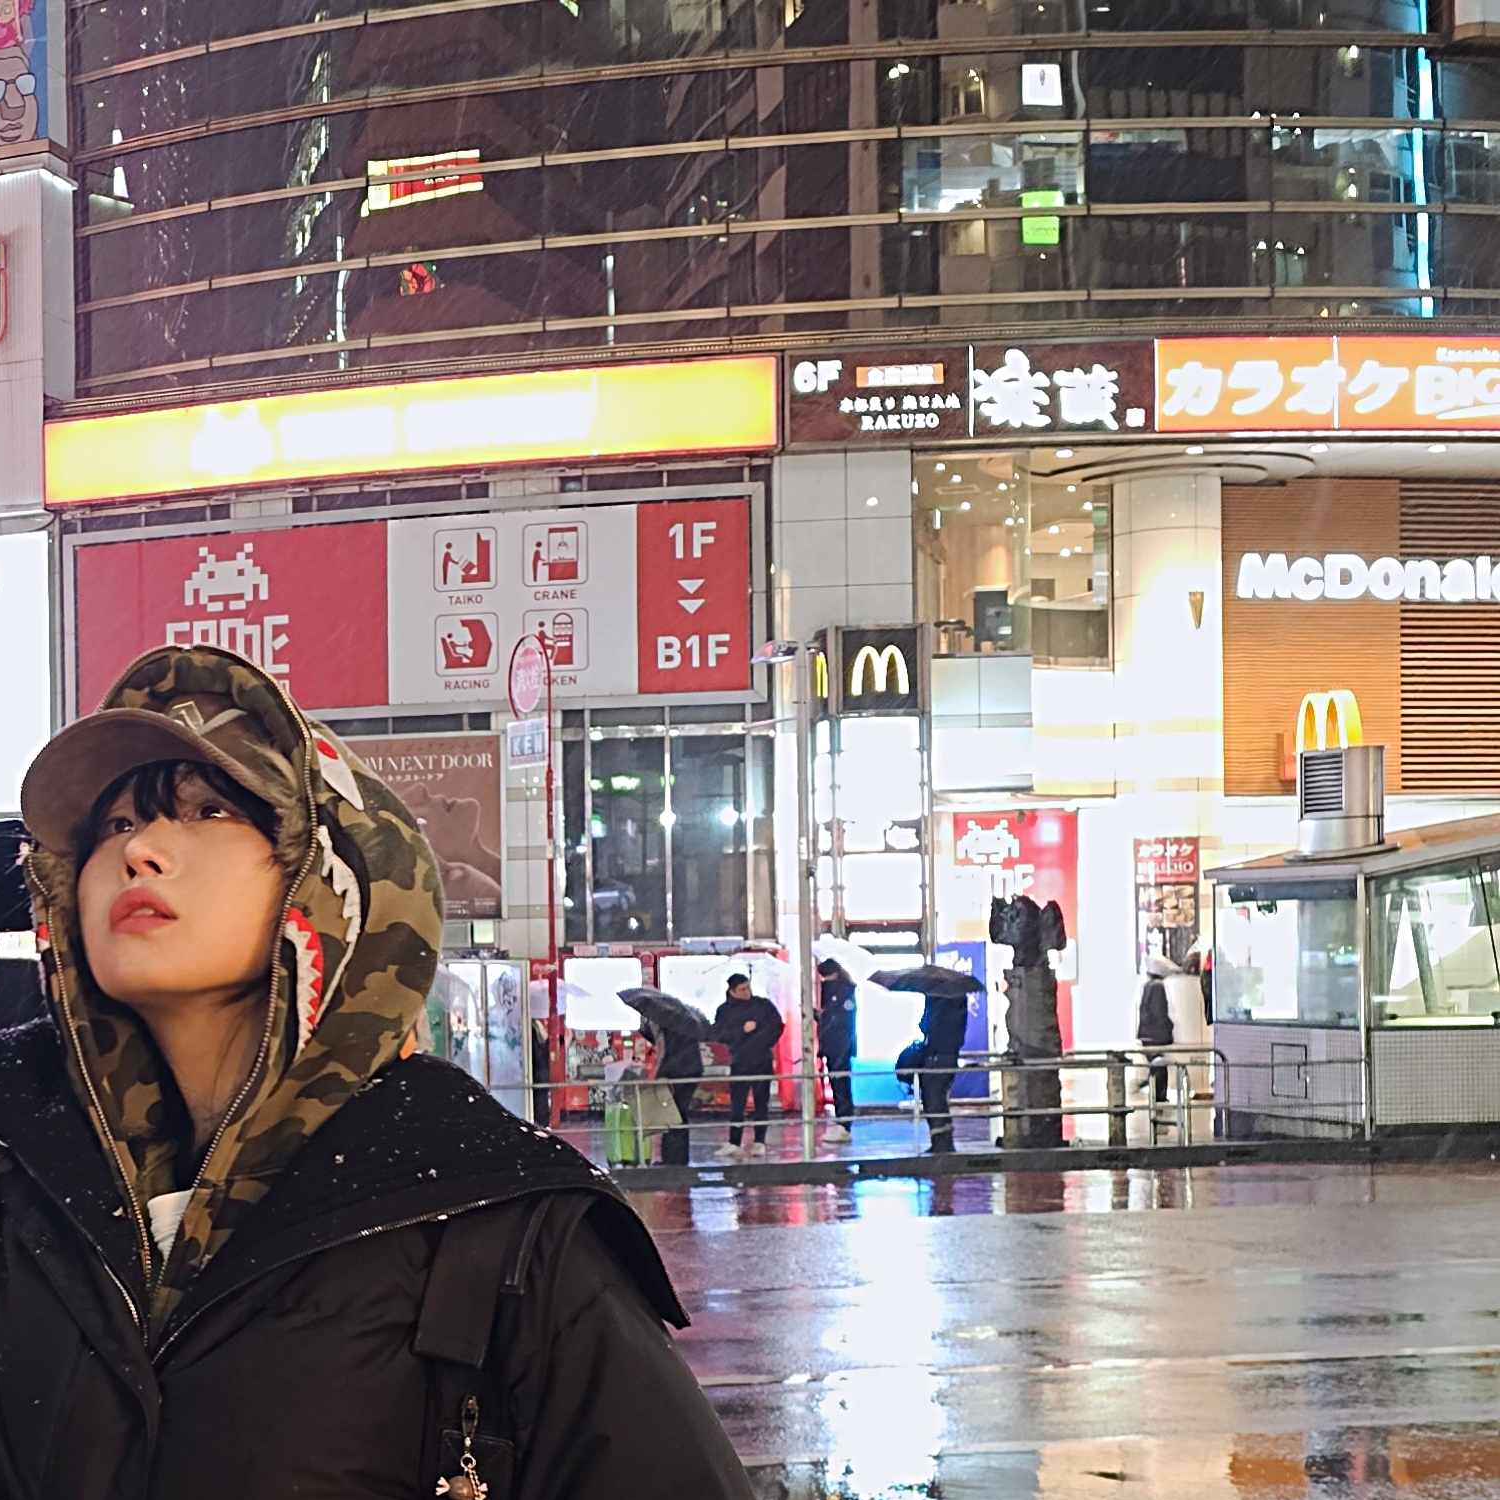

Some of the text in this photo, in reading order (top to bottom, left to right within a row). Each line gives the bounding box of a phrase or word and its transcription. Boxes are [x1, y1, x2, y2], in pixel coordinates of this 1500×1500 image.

[794, 359, 842, 394] 6F
[1162, 359, 1410, 417] カラオケ
[861, 412, 940, 431] RAKUZO
[668, 520, 717, 559] 1F
[447, 588, 578, 606] TAIKO CRANE
[656, 633, 731, 671] B1F
[444, 675, 577, 691] RACING OKEN
[387, 754, 438, 772] NEXT
[441, 752, 494, 770] DOOR
